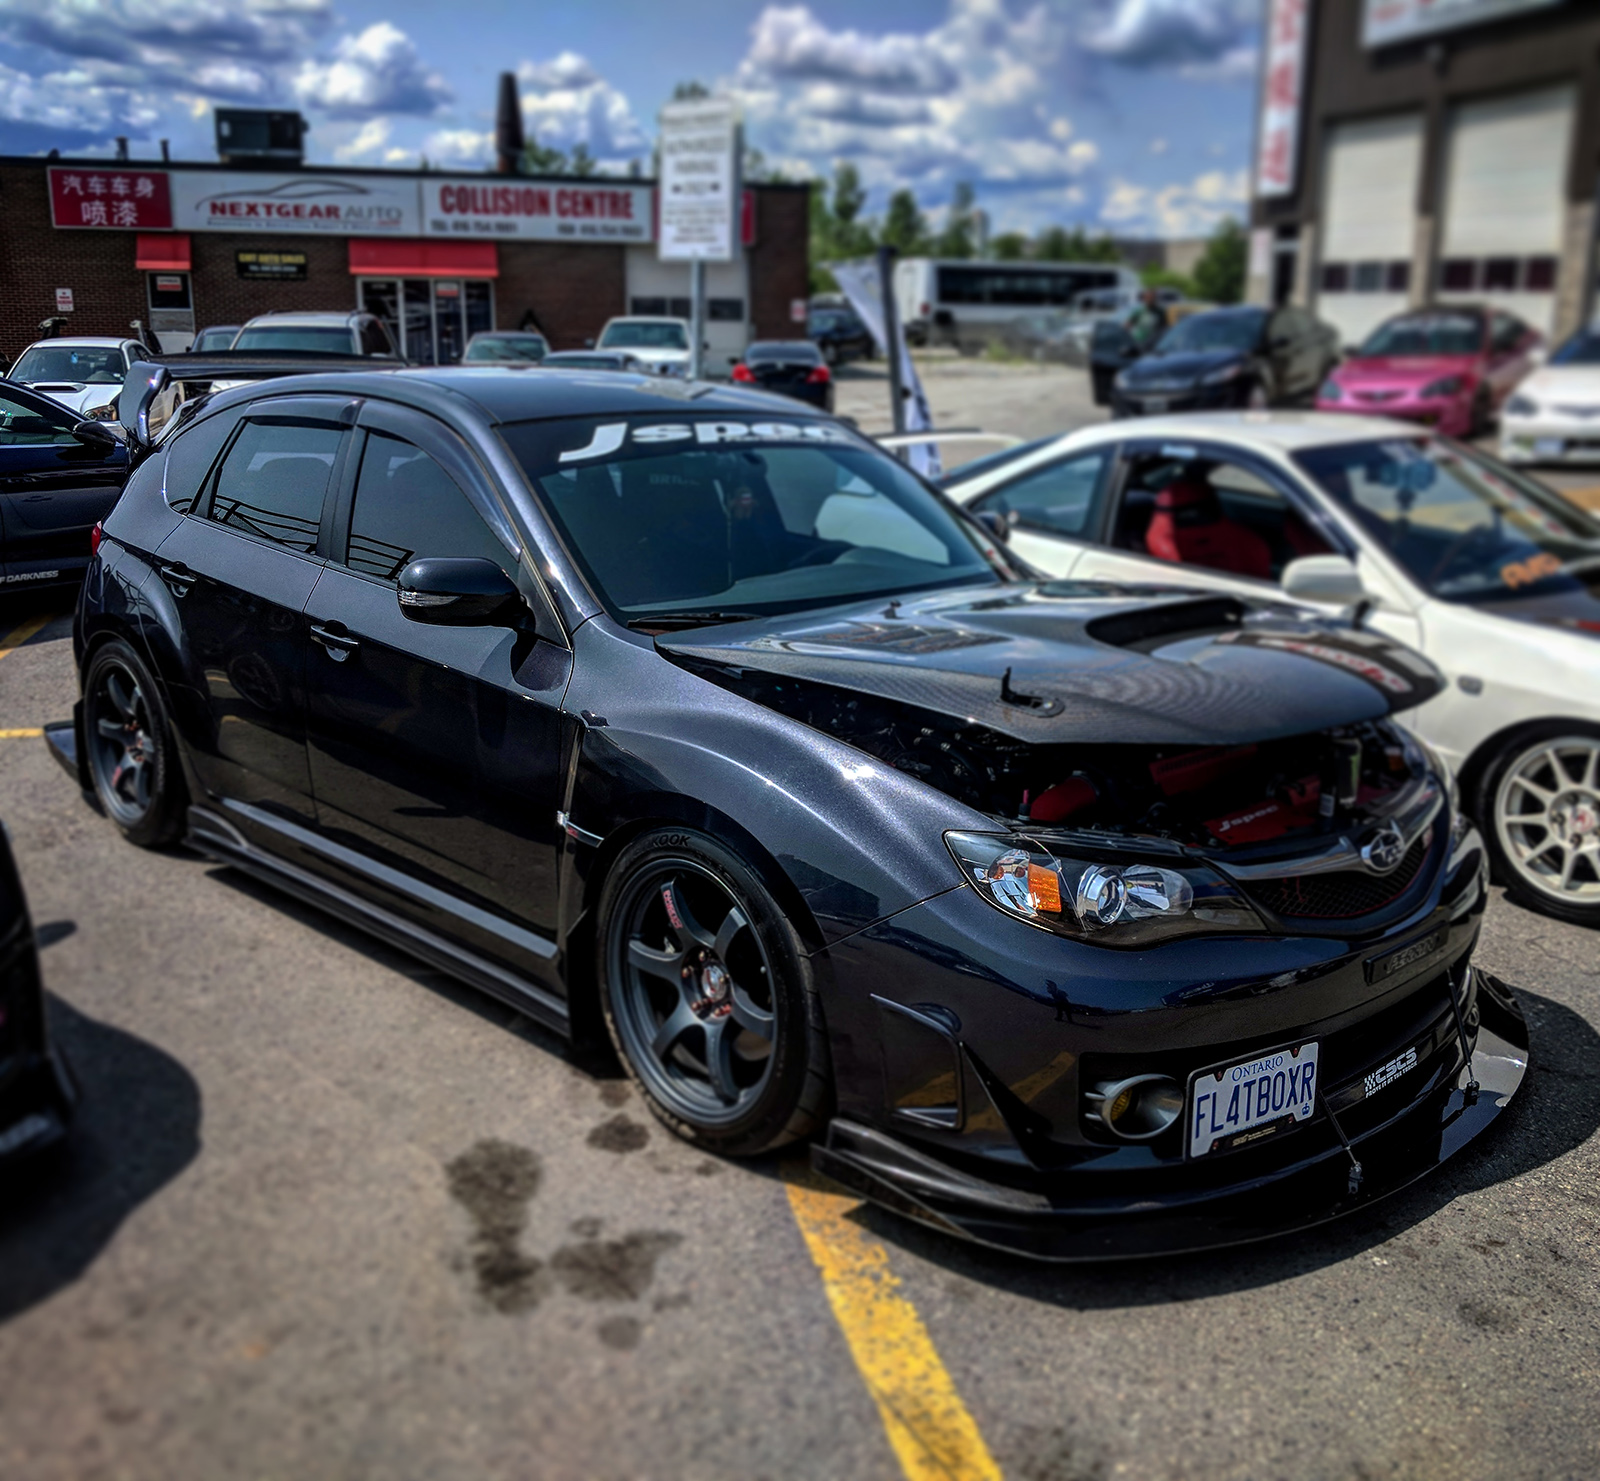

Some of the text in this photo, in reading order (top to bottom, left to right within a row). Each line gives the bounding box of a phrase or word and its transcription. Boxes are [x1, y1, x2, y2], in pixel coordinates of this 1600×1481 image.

[62, 174, 156, 198] 汽车车身
[81, 199, 138, 227] 喷漆
[210, 202, 404, 220] NEXTGEAR AUTO
[439, 184, 635, 220] COLLISION CENTRE
[6, 570, 59, 583] DARKNESS
[1231, 1055, 1284, 1082] ONTARIO
[1195, 1061, 1315, 1140] FL4TBOXR
